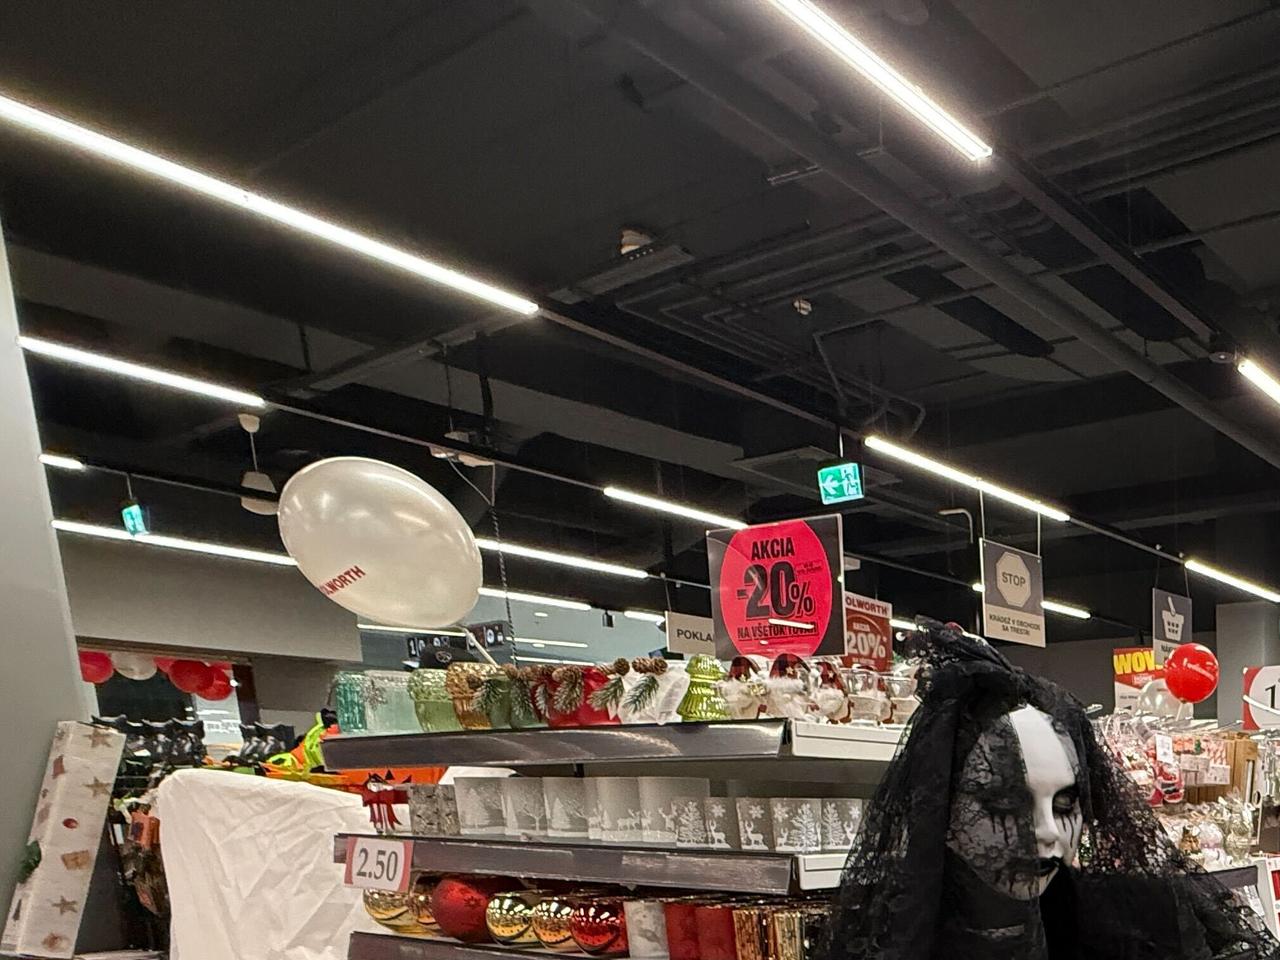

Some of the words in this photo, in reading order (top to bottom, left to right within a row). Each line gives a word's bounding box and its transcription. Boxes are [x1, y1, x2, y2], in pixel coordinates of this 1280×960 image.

[751, 537, 795, 560] AKCIA
[1002, 572, 1026, 587] STOP
[737, 561, 815, 619] -20%
[845, 597, 888, 614] OLWORTH
[677, 629, 713, 642] POKLA
[356, 848, 398, 881] 2.50
